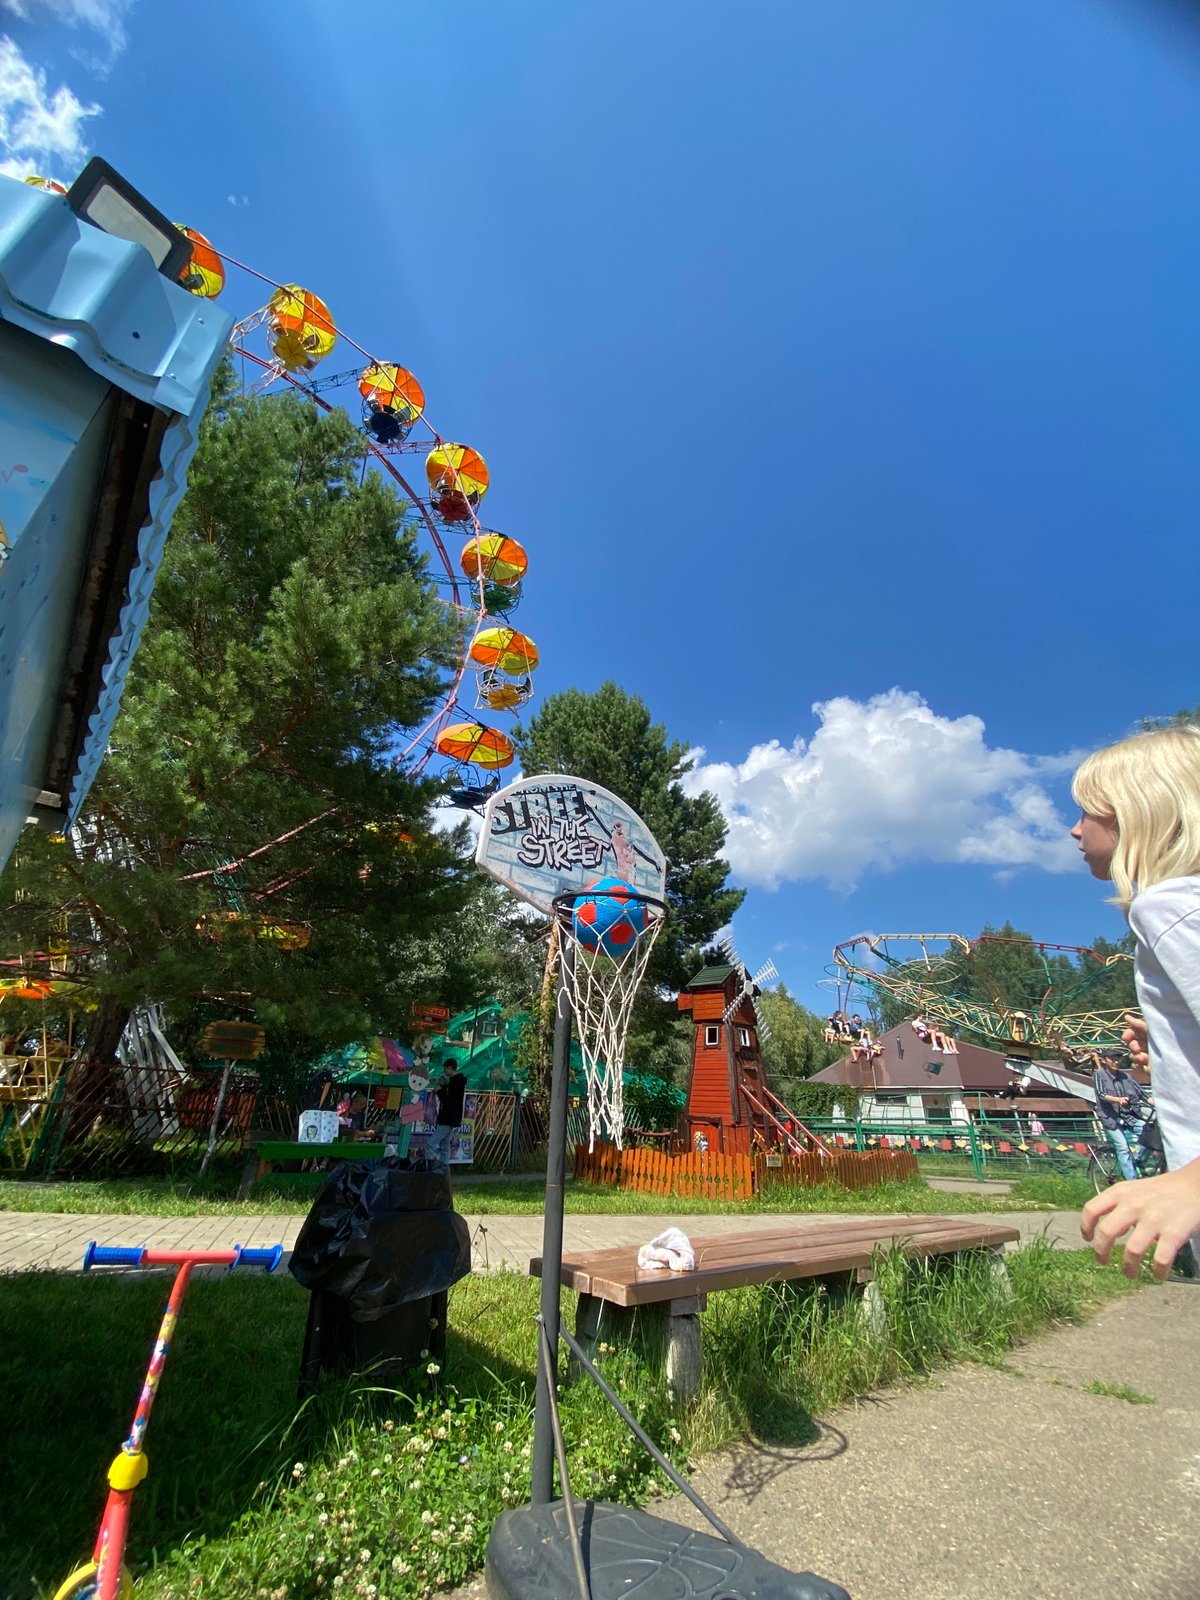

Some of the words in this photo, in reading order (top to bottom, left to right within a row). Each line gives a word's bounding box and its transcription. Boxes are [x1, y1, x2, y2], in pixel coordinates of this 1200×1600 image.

[530, 815, 552, 838] IN
[553, 814, 594, 839] THE
[518, 834, 610, 871] STREET
